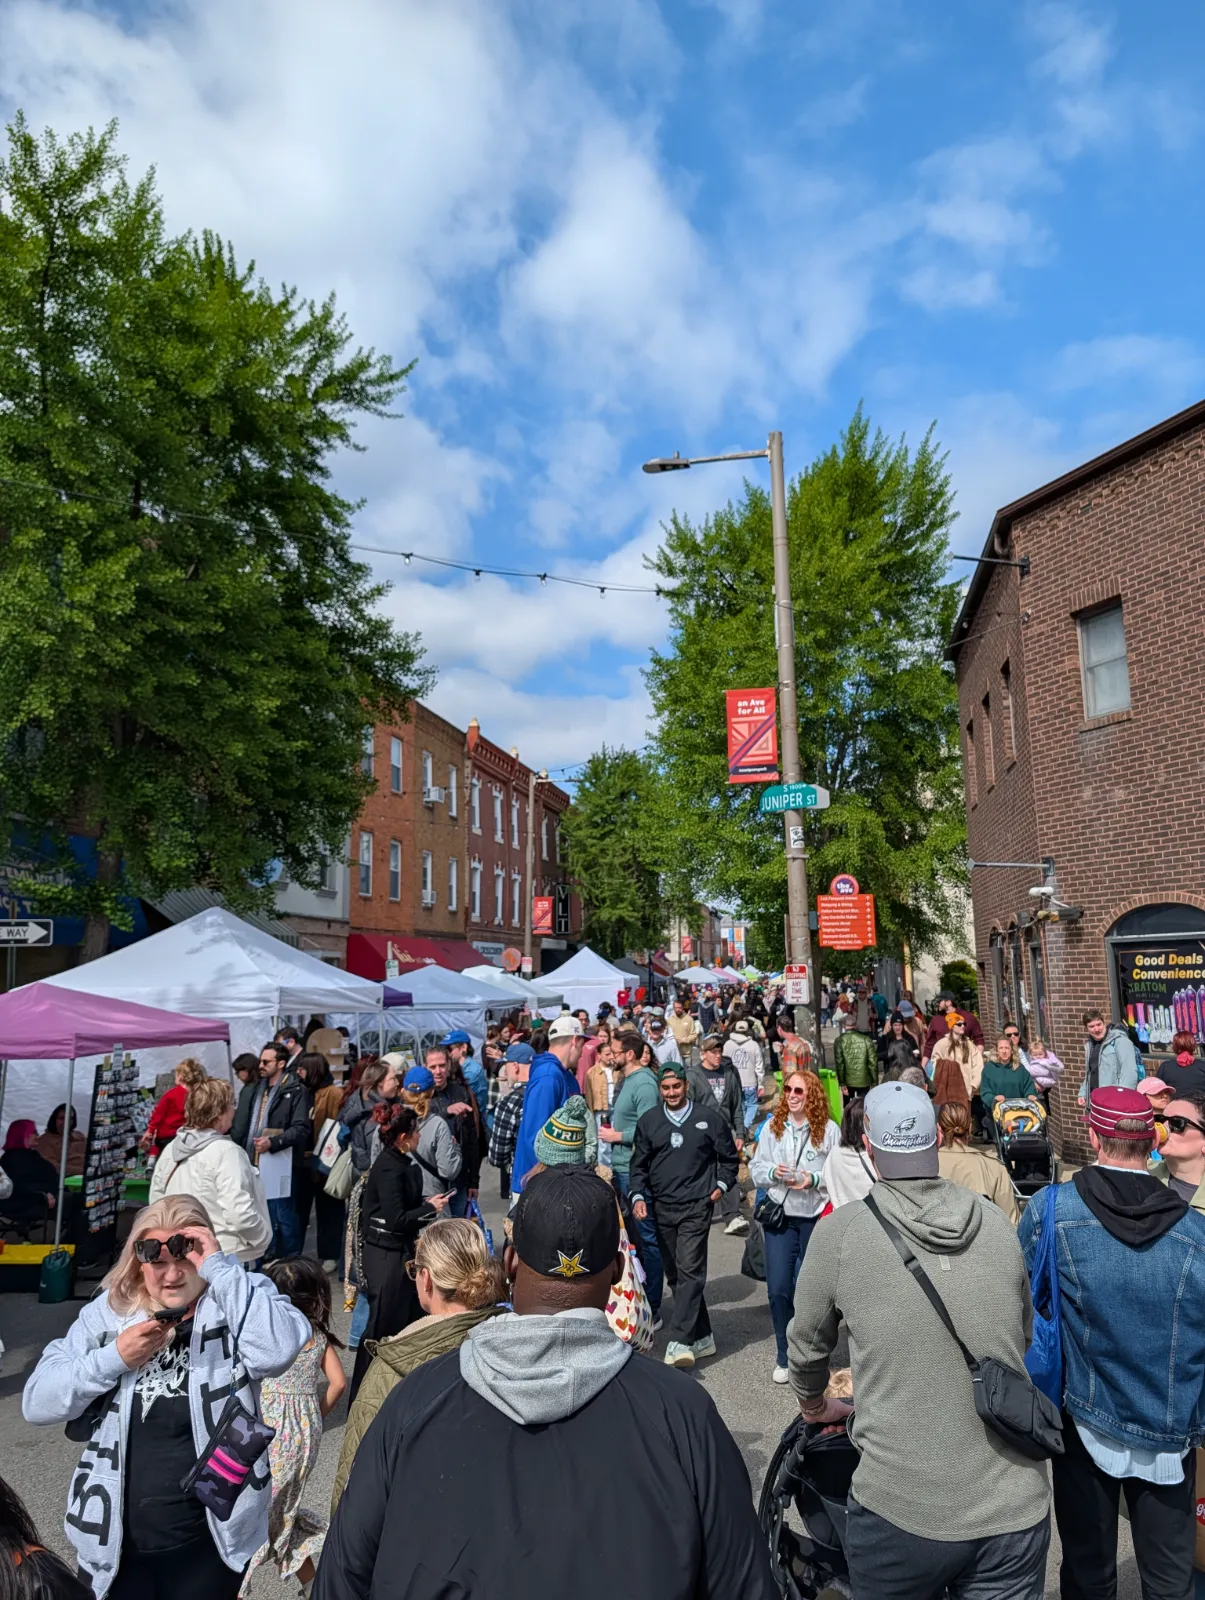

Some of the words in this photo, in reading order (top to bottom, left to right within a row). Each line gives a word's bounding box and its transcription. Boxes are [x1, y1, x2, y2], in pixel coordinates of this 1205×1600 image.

[737, 699, 748, 707] an
[749, 698, 765, 706] Ave
[737, 706, 752, 715] for
[753, 705, 766, 714] All
[783, 785, 788, 793] S
[761, 792, 803, 811] JUNIPER
[806, 795, 816, 805] ST
[836, 882, 850, 890] the
[6, 928, 28, 938] WAY
[1135, 954, 1166, 966] Good
[1168, 953, 1203, 965] Deals
[881, 1131, 930, 1148] Champions
